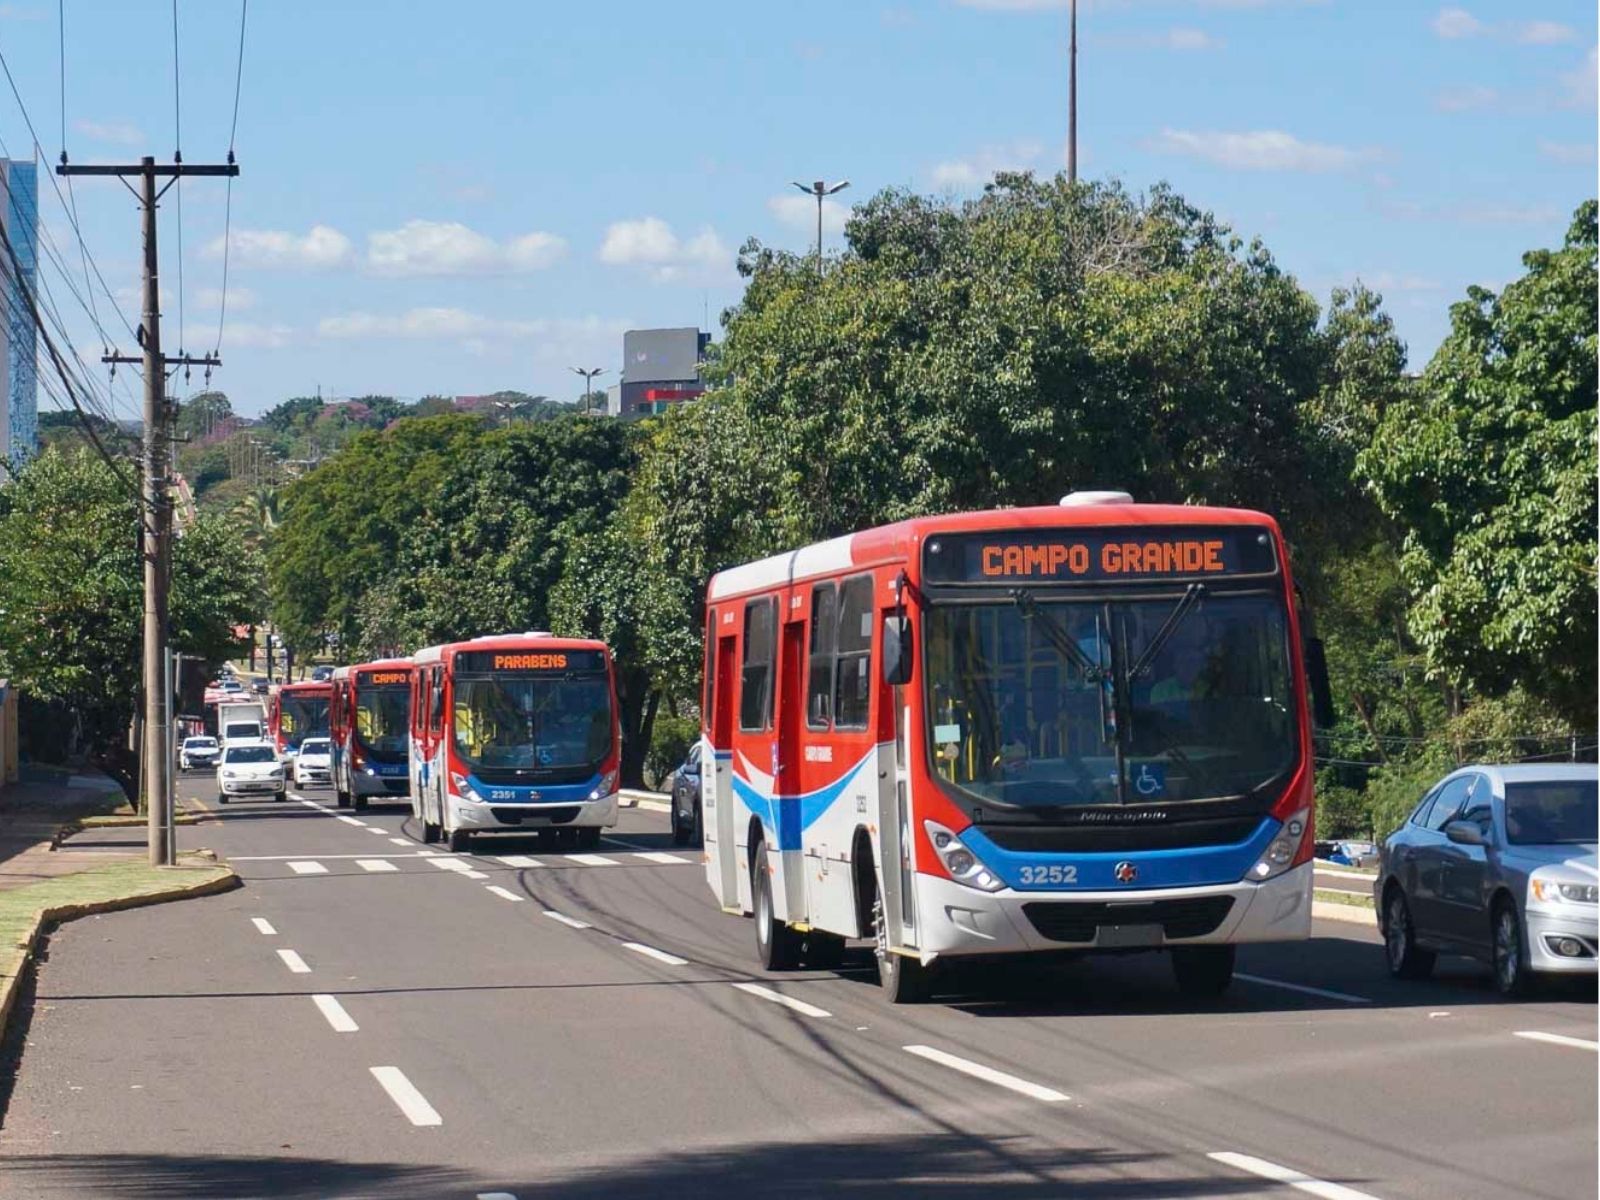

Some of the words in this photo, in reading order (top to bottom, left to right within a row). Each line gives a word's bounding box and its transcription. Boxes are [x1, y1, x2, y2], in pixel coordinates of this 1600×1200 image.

[982, 544, 1089, 576] CAMPO
[1102, 541, 1224, 573] GRANDE
[494, 654, 567, 669] PARABENS
[373, 673, 406, 684] CAMPO
[1019, 865, 1078, 884] 3252
